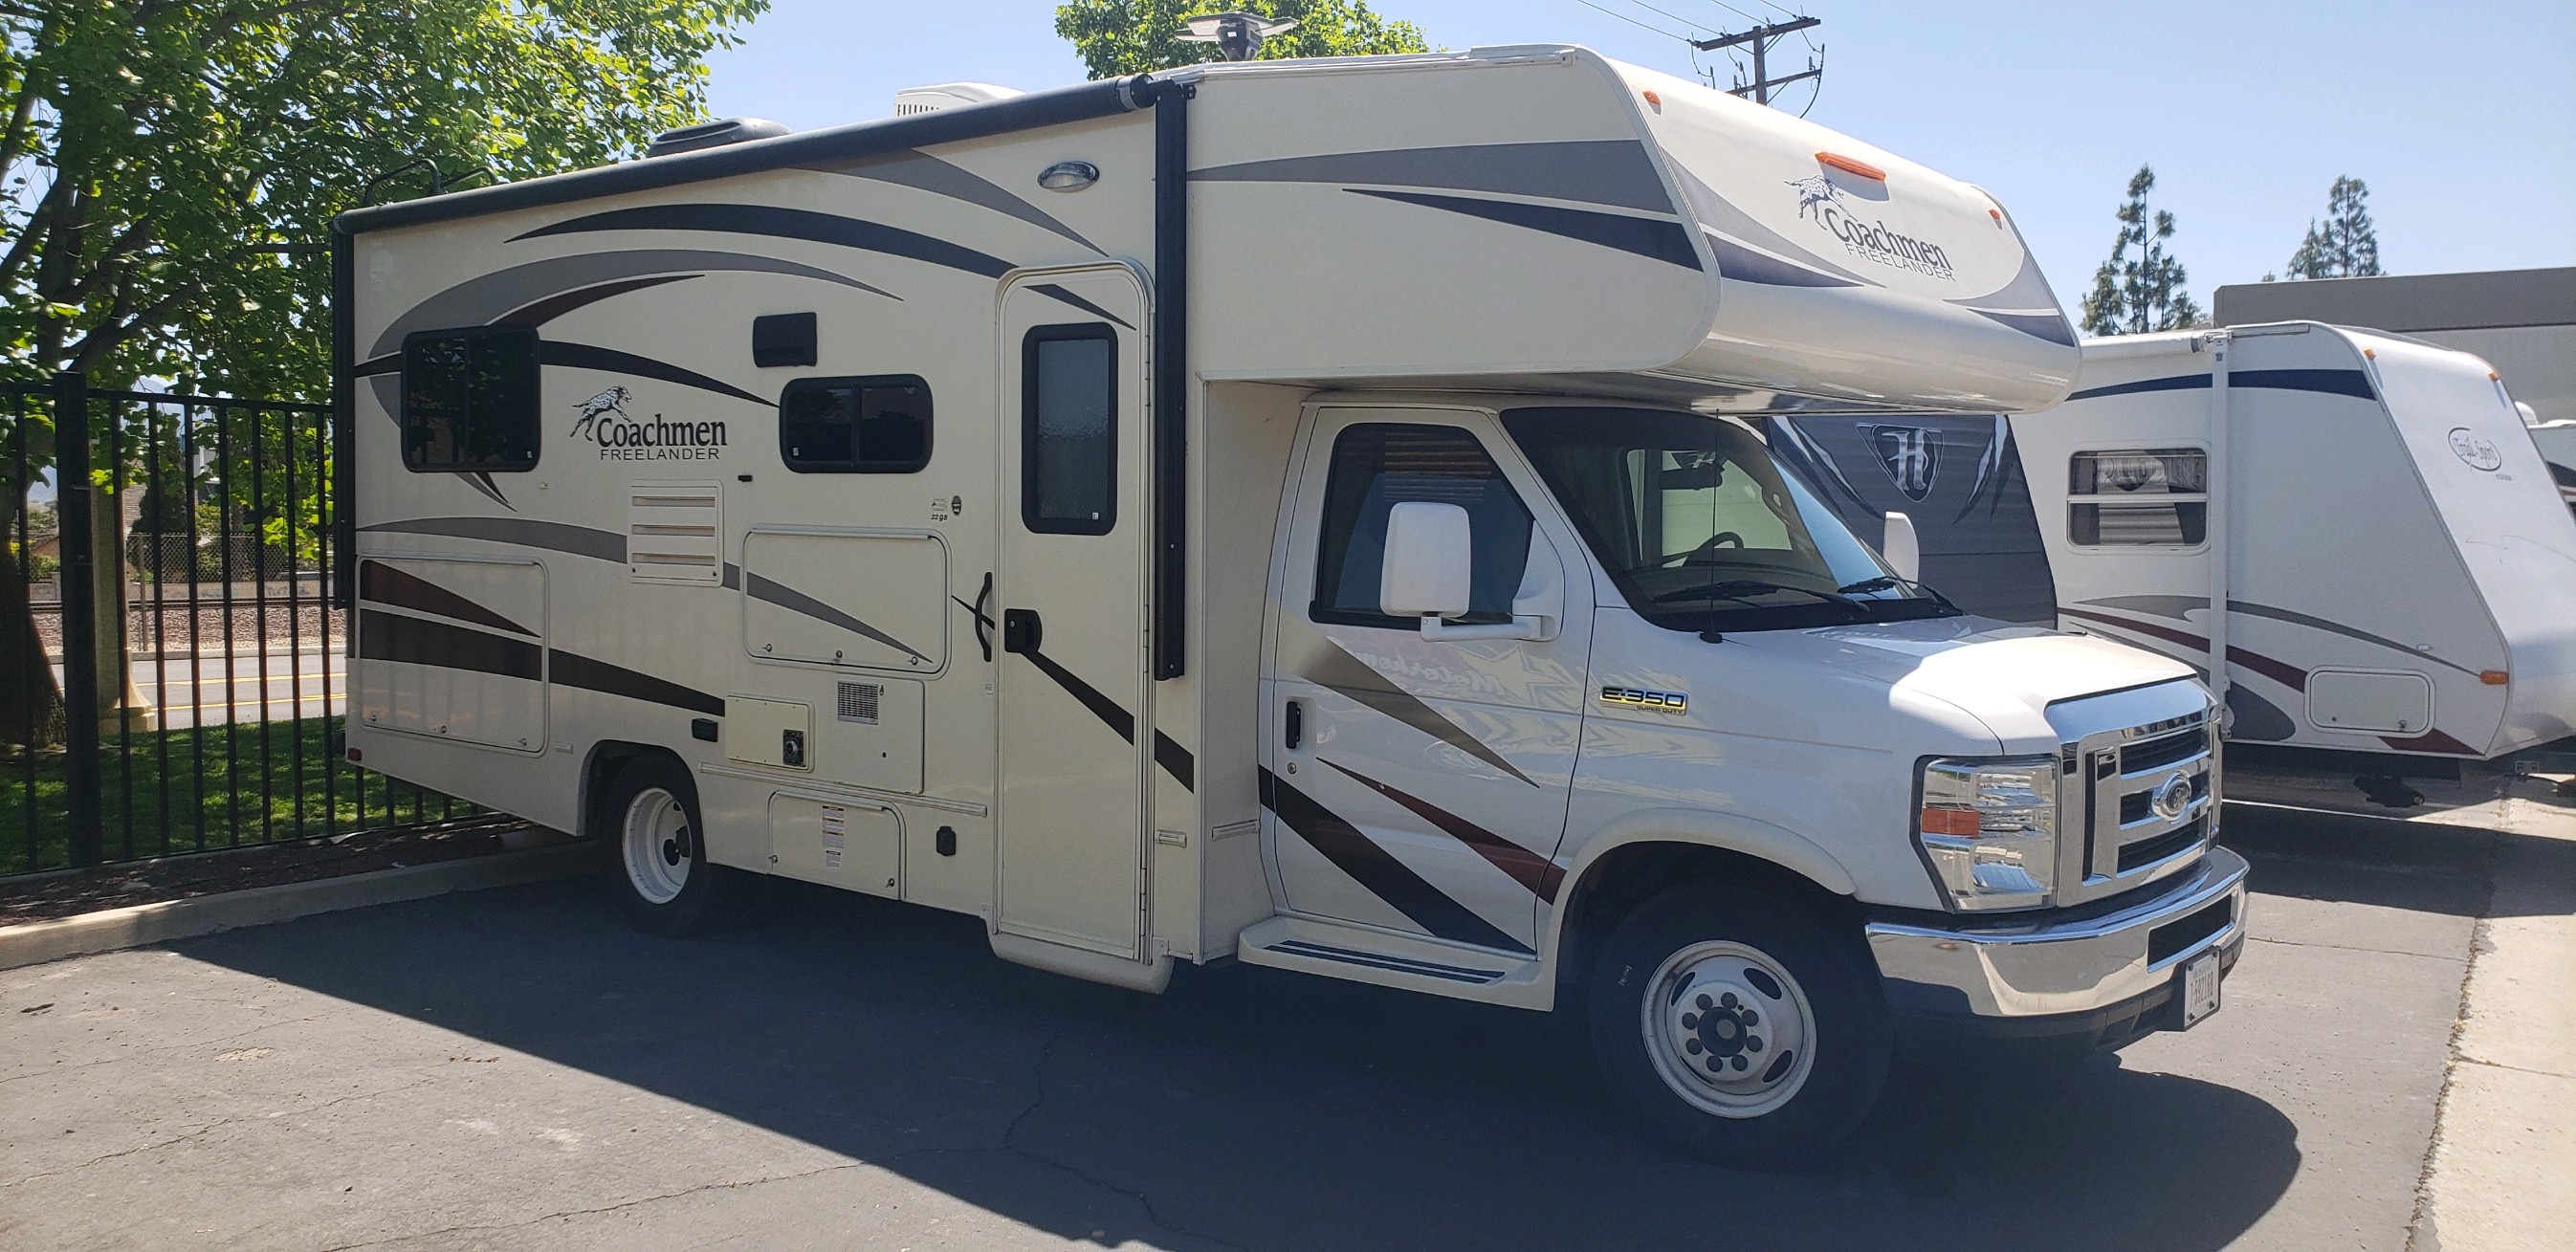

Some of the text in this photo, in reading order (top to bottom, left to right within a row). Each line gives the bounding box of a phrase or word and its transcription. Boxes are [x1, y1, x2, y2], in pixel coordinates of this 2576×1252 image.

[1824, 208, 1952, 271] Coachmen
[1846, 243, 1956, 282] FREELANDER
[597, 413, 727, 447] Coachmen
[600, 448, 719, 460] FREELANDER
[1601, 687, 1684, 707] E-350
